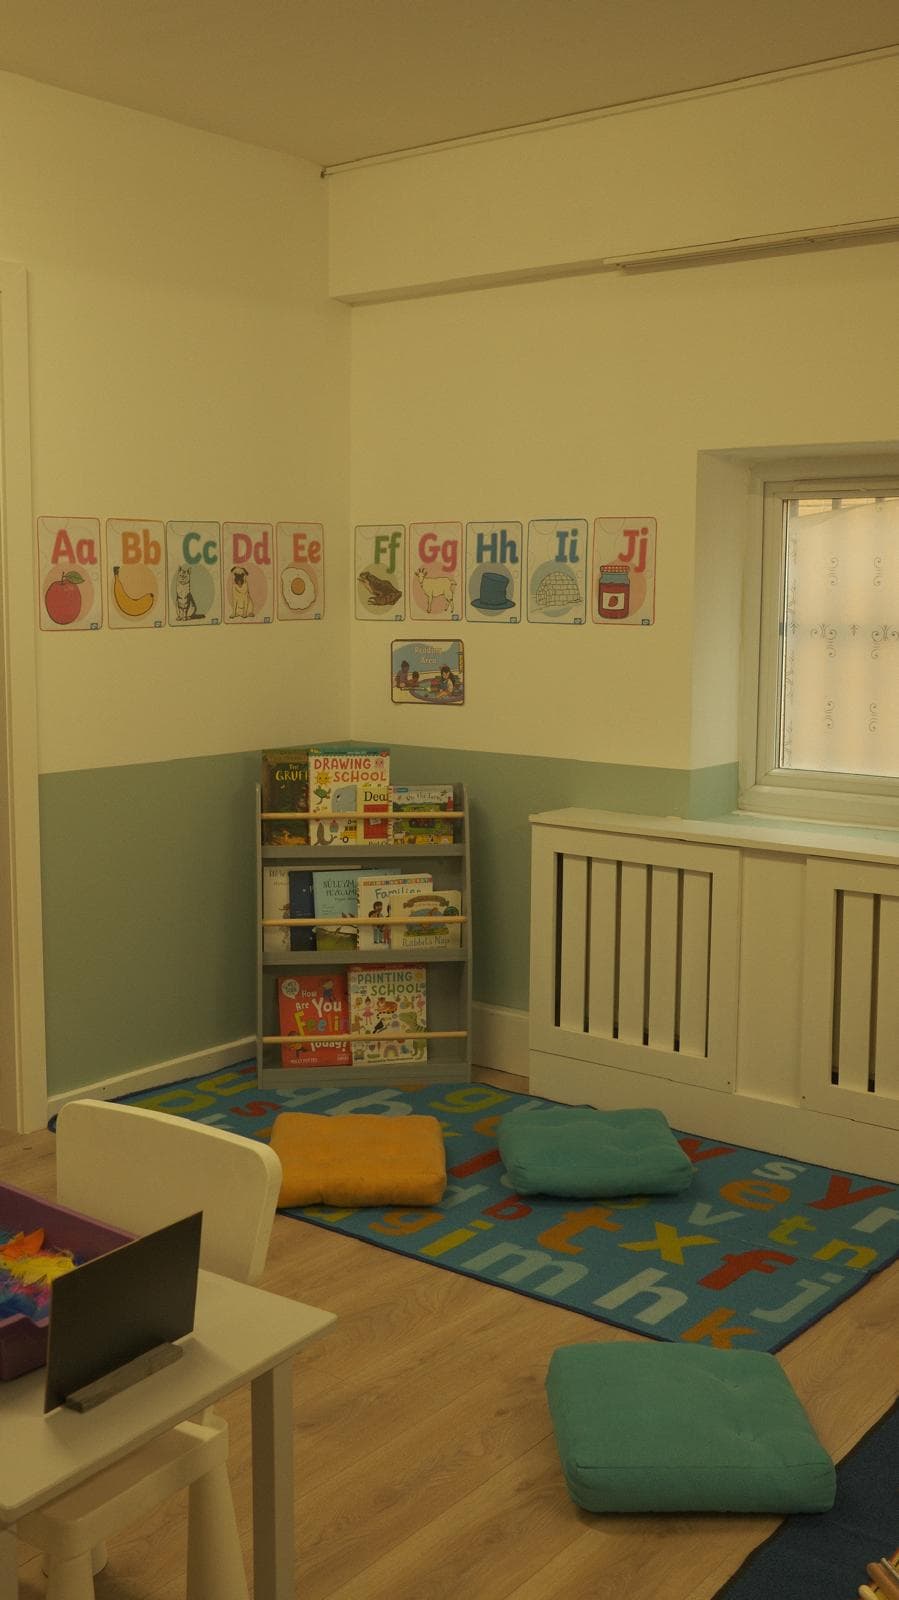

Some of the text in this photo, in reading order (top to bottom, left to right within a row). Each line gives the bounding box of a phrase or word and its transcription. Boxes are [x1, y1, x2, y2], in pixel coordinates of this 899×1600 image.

[51, 529, 98, 565] Aa
[121, 531, 161, 566] Bb
[182, 532, 218, 565] Cc
[232, 531, 271, 565] Dd
[292, 532, 321, 563] Ee
[374, 531, 402, 574] Ff
[418, 532, 459, 572] Gg
[476, 529, 519, 564] Hh
[555, 528, 580, 564] Ii
[617, 527, 649, 573] Jj
[314, 758, 371, 770] DRAWING
[333, 771, 387, 783] SCHOOL
[301, 990, 318, 998] How
[358, 972, 412, 985] PAINTING
[370, 983, 422, 996] SCHOOL
[295, 997, 342, 1018] Are You
[719, 1179, 792, 1211] e
[617, 1221, 721, 1265] x
[459, 1242, 590, 1296] m
[592, 1267, 689, 1325] h
